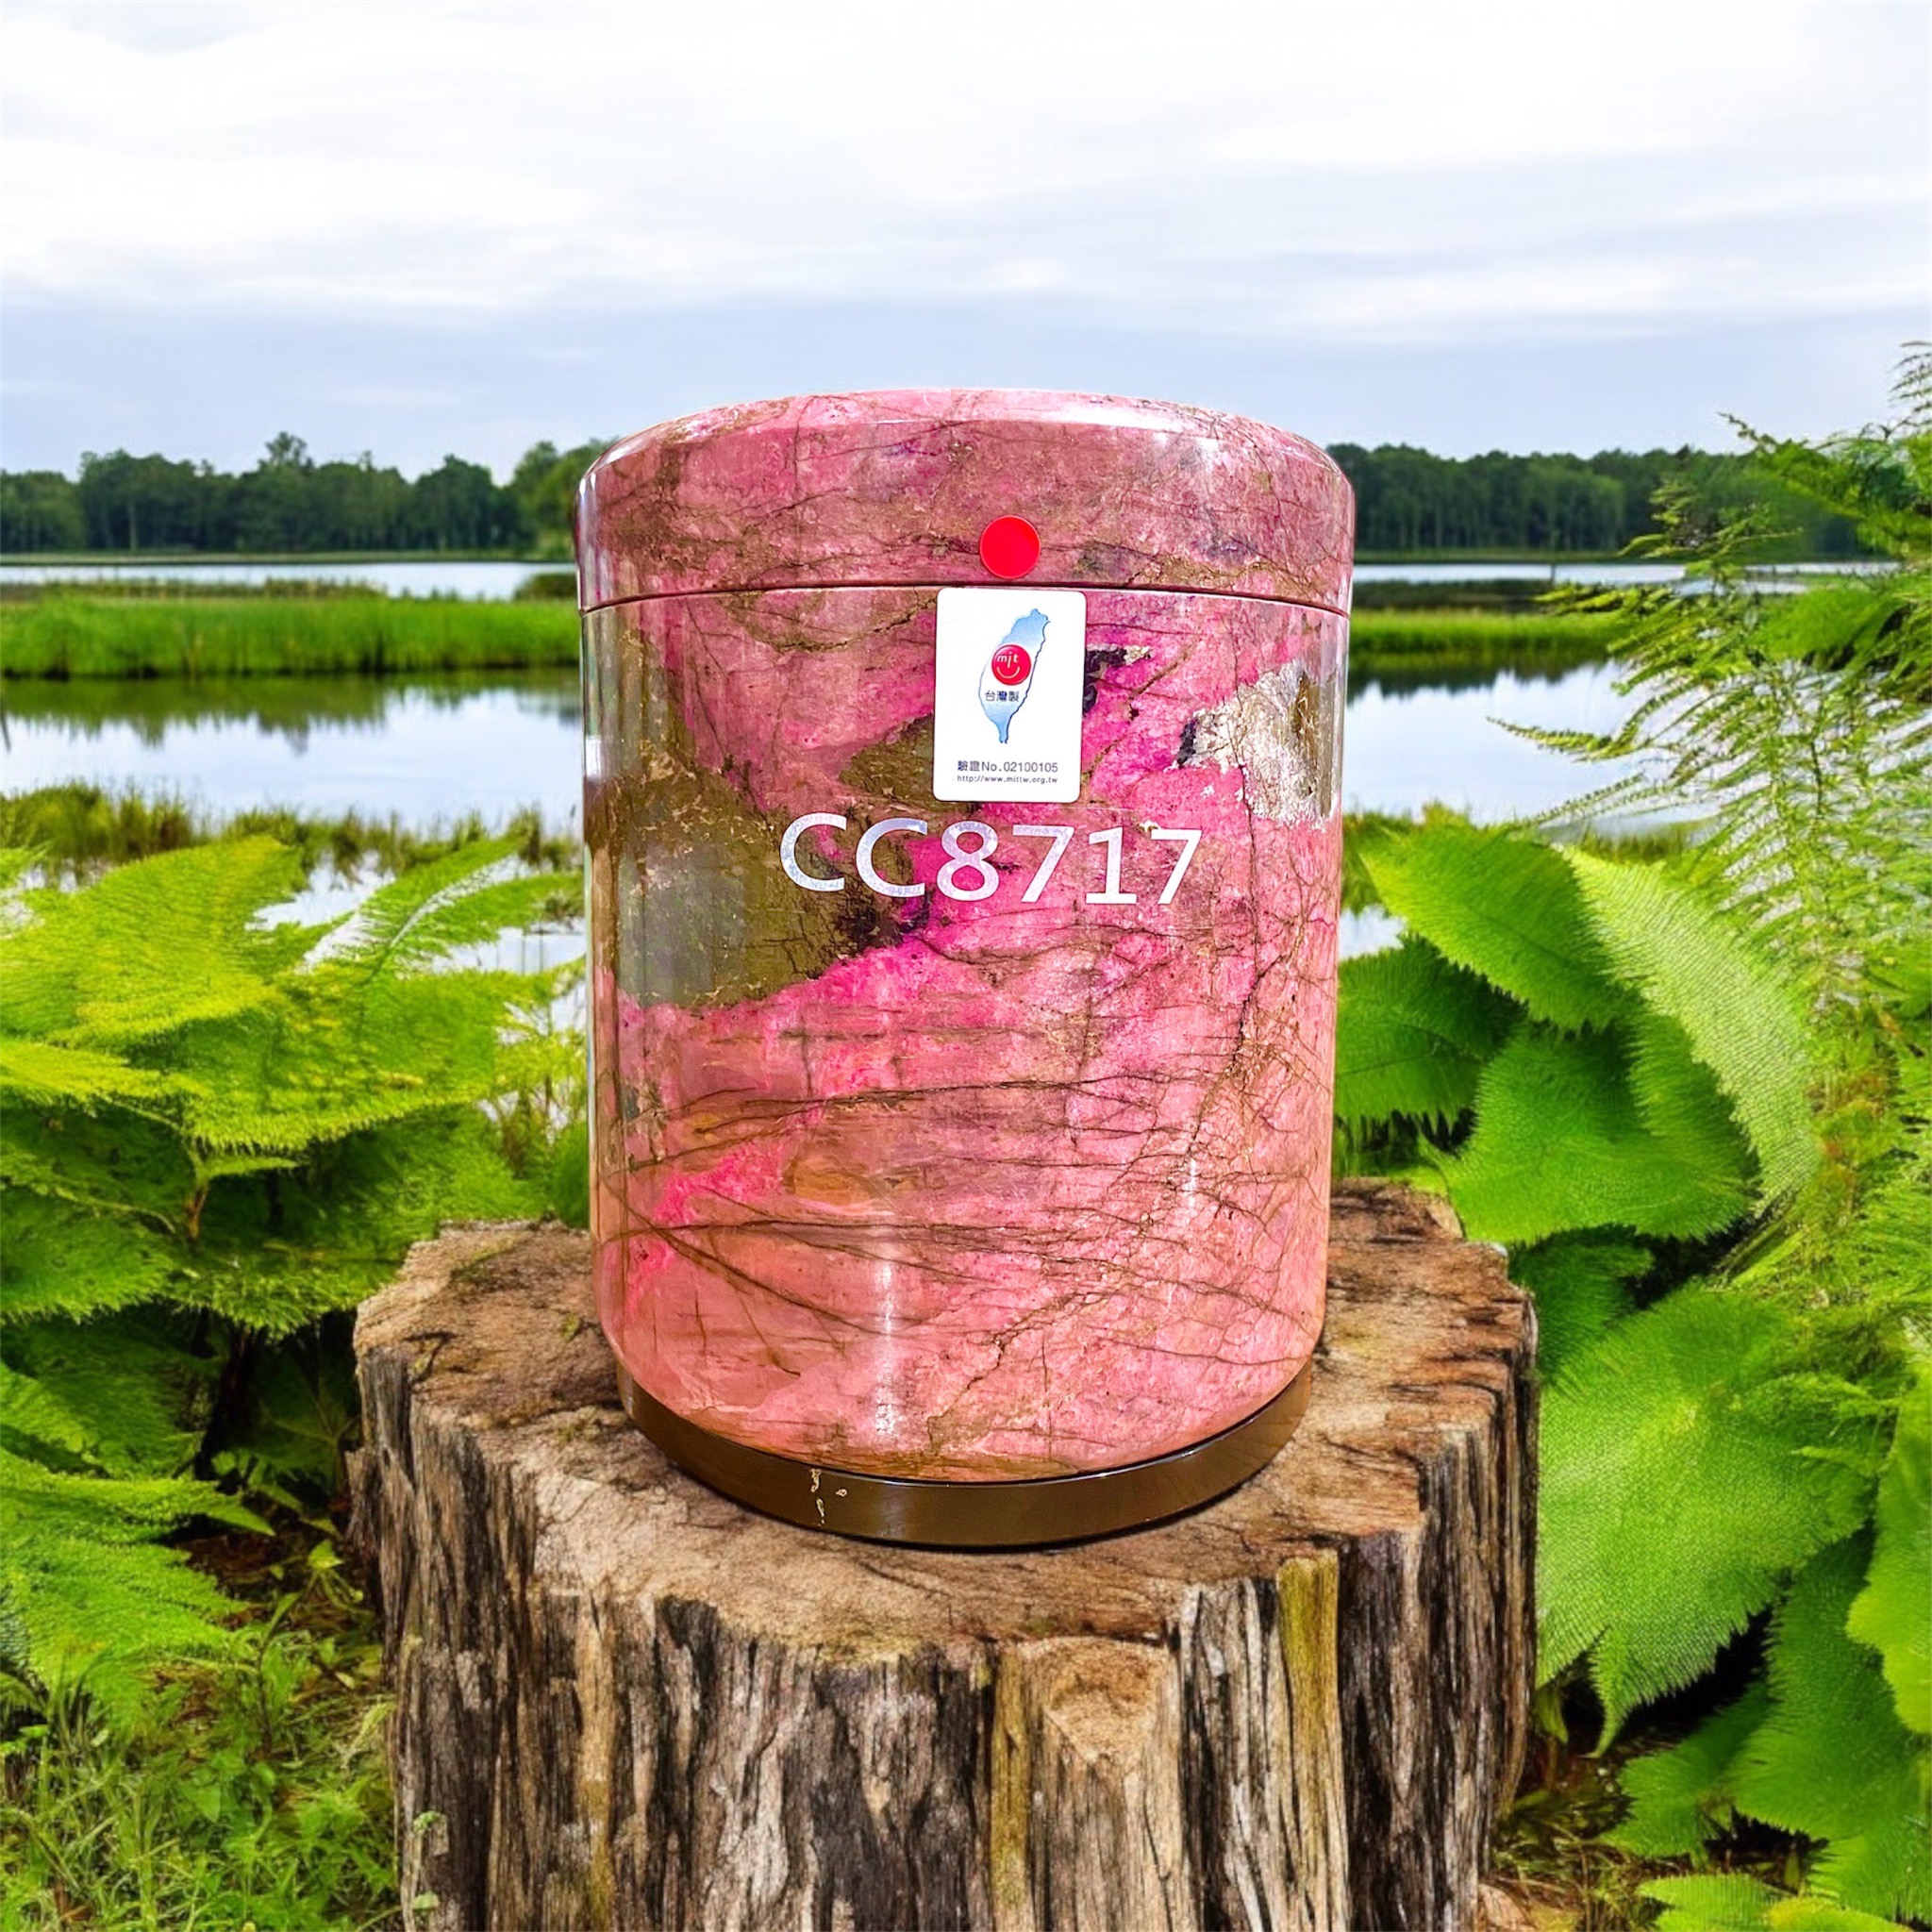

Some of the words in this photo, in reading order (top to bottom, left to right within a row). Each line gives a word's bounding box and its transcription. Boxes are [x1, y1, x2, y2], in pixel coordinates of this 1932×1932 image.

[997, 651, 1019, 668] mit
[985, 690, 1019, 702] 台灣製
[958, 775, 1058, 785] http://www.mittw.org.tw
[780, 812, 1203, 905] CC8717
